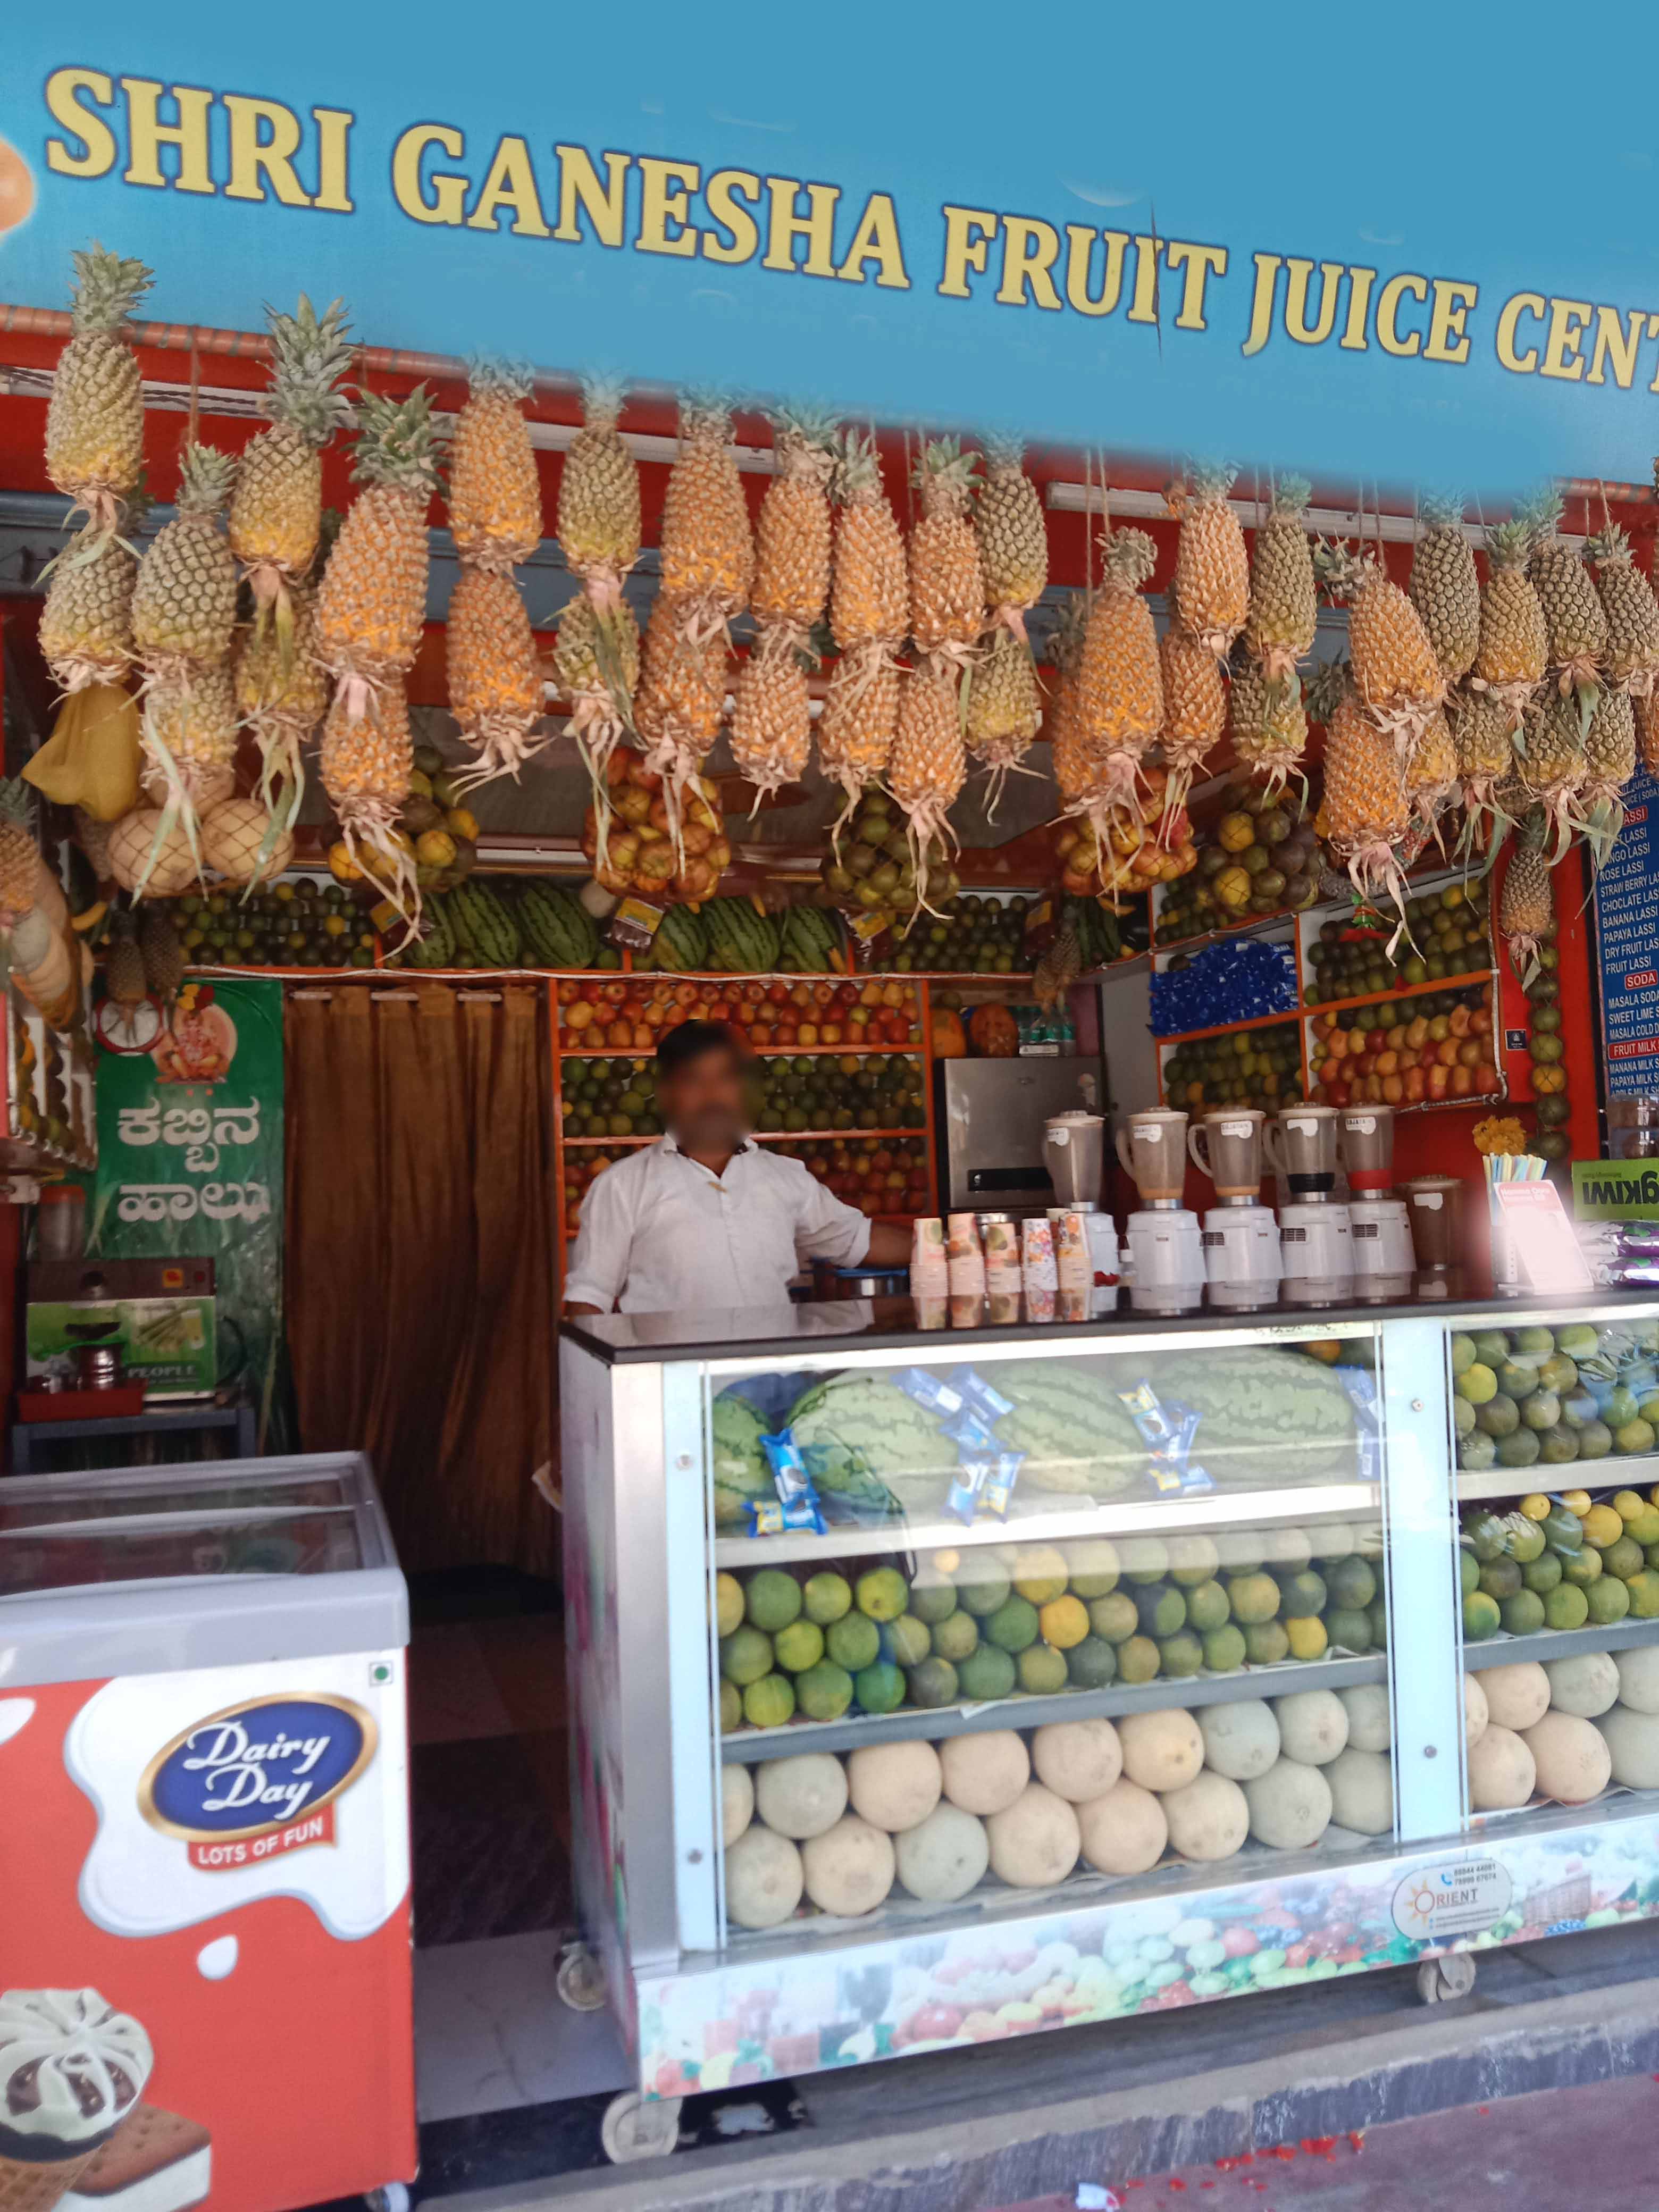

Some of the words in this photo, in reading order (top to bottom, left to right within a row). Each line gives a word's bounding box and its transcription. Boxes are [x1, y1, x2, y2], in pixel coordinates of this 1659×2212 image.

[46, 68, 353, 212] SHRI
[391, 125, 909, 288] GANESHA
[938, 204, 1227, 330] FRUIT
[1243, 255, 1478, 363] JUICE
[1624, 808, 1645, 825] ASSI
[1625, 827, 1647, 843] LASSI
[1628, 842, 1650, 859] LASSI
[1599, 867, 1620, 882] ROSE
[1622, 860, 1644, 876] LASSI
[1602, 894, 1641, 913] CHOCLATE
[1603, 911, 1635, 928] BANANA
[1635, 905, 1658, 920] LASSI
[1604, 927, 1632, 943] PAPAYA
[1633, 922, 1655, 937] LASSI
[1605, 946, 1620, 959] DRY
[1621, 941, 1642, 957] FRUIT
[1606, 960, 1627, 974] FRUIT
[1629, 955, 1651, 970] LASSI
[1627, 973, 1655, 987] SODA
[1608, 994, 1639, 1009] MASALA
[1608, 1010, 1635, 1025] SWEET
[1636, 1007, 1654, 1020] LIME
[1610, 1026, 1636, 1040] MASALA
[1636, 1024, 1653, 1036] COLD
[1614, 1043, 1636, 1056] FRUIT
[1638, 1040, 1656, 1053] MILK
[1638, 1058, 1654, 1070] MILK
[1611, 1075, 1635, 1088] PAPAYA
[1636, 1073, 1652, 1085] MILK
[117, 1095, 260, 1172] ಕಬ್ಬಿನ
[117, 1182, 270, 1222] ಹಾಲು
[183, 1720, 331, 1774] Dairy
[202, 1762, 313, 1820] Day
[198, 1844, 247, 1865] LOTS
[253, 1836, 279, 1856] OF
[284, 1817, 323, 1847] FUN
